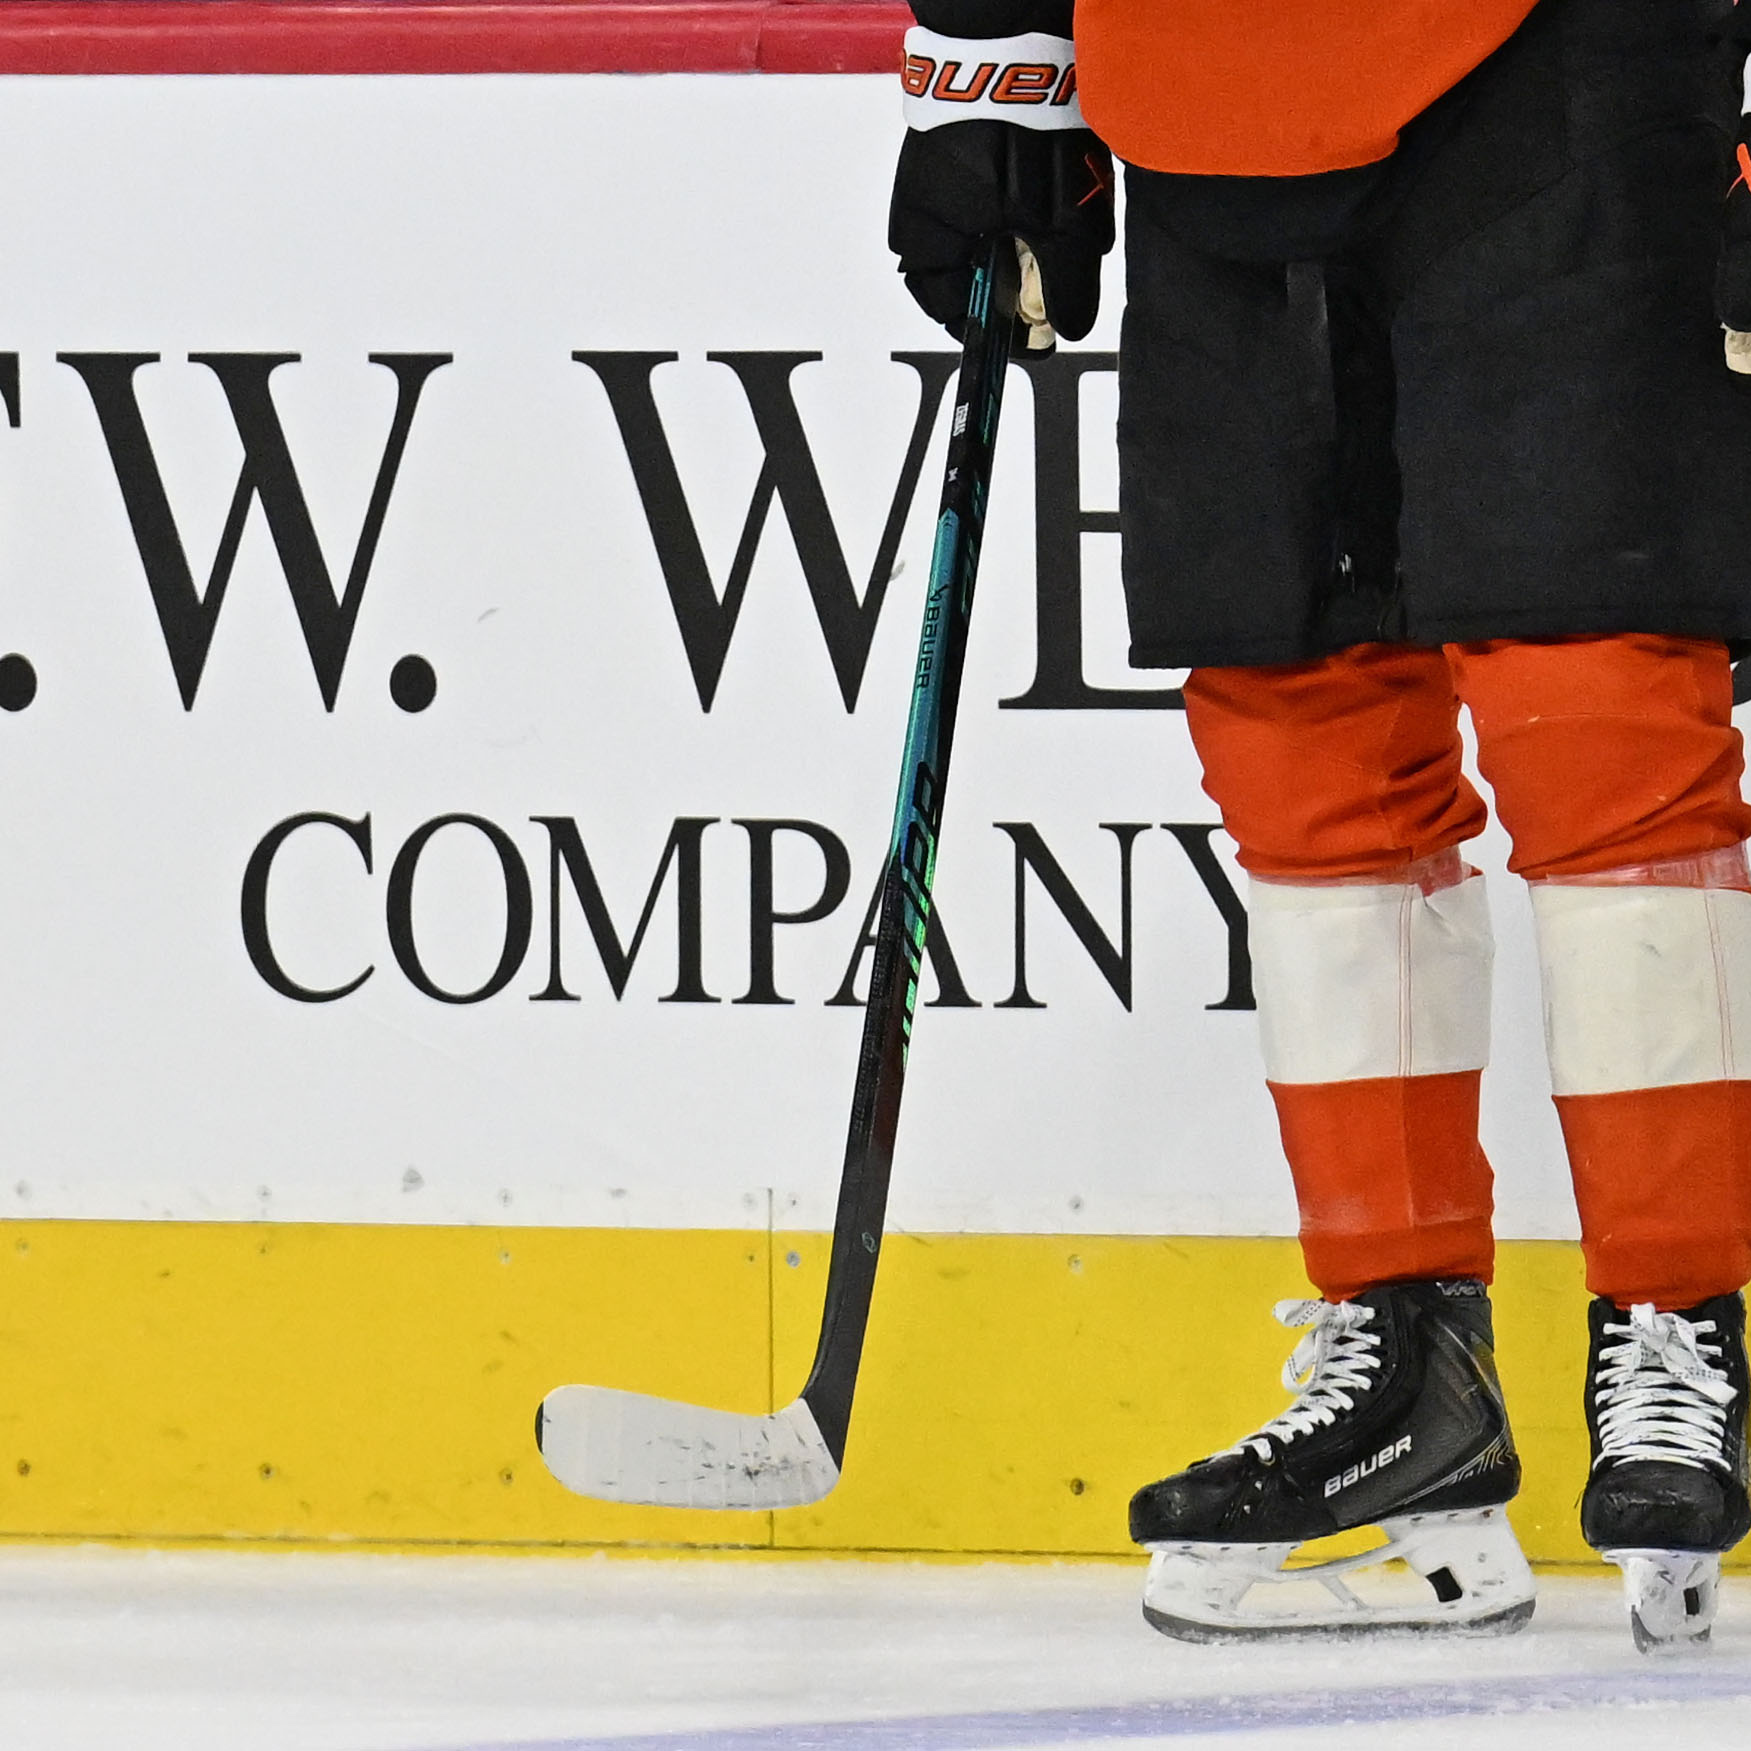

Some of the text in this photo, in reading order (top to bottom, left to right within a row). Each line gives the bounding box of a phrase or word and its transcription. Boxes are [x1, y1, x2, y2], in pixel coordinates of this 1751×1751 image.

[915, 605, 940, 689] BAUER
[240, 810, 1258, 1013] COMPANY
[1324, 1434, 1413, 1499] BAUER
